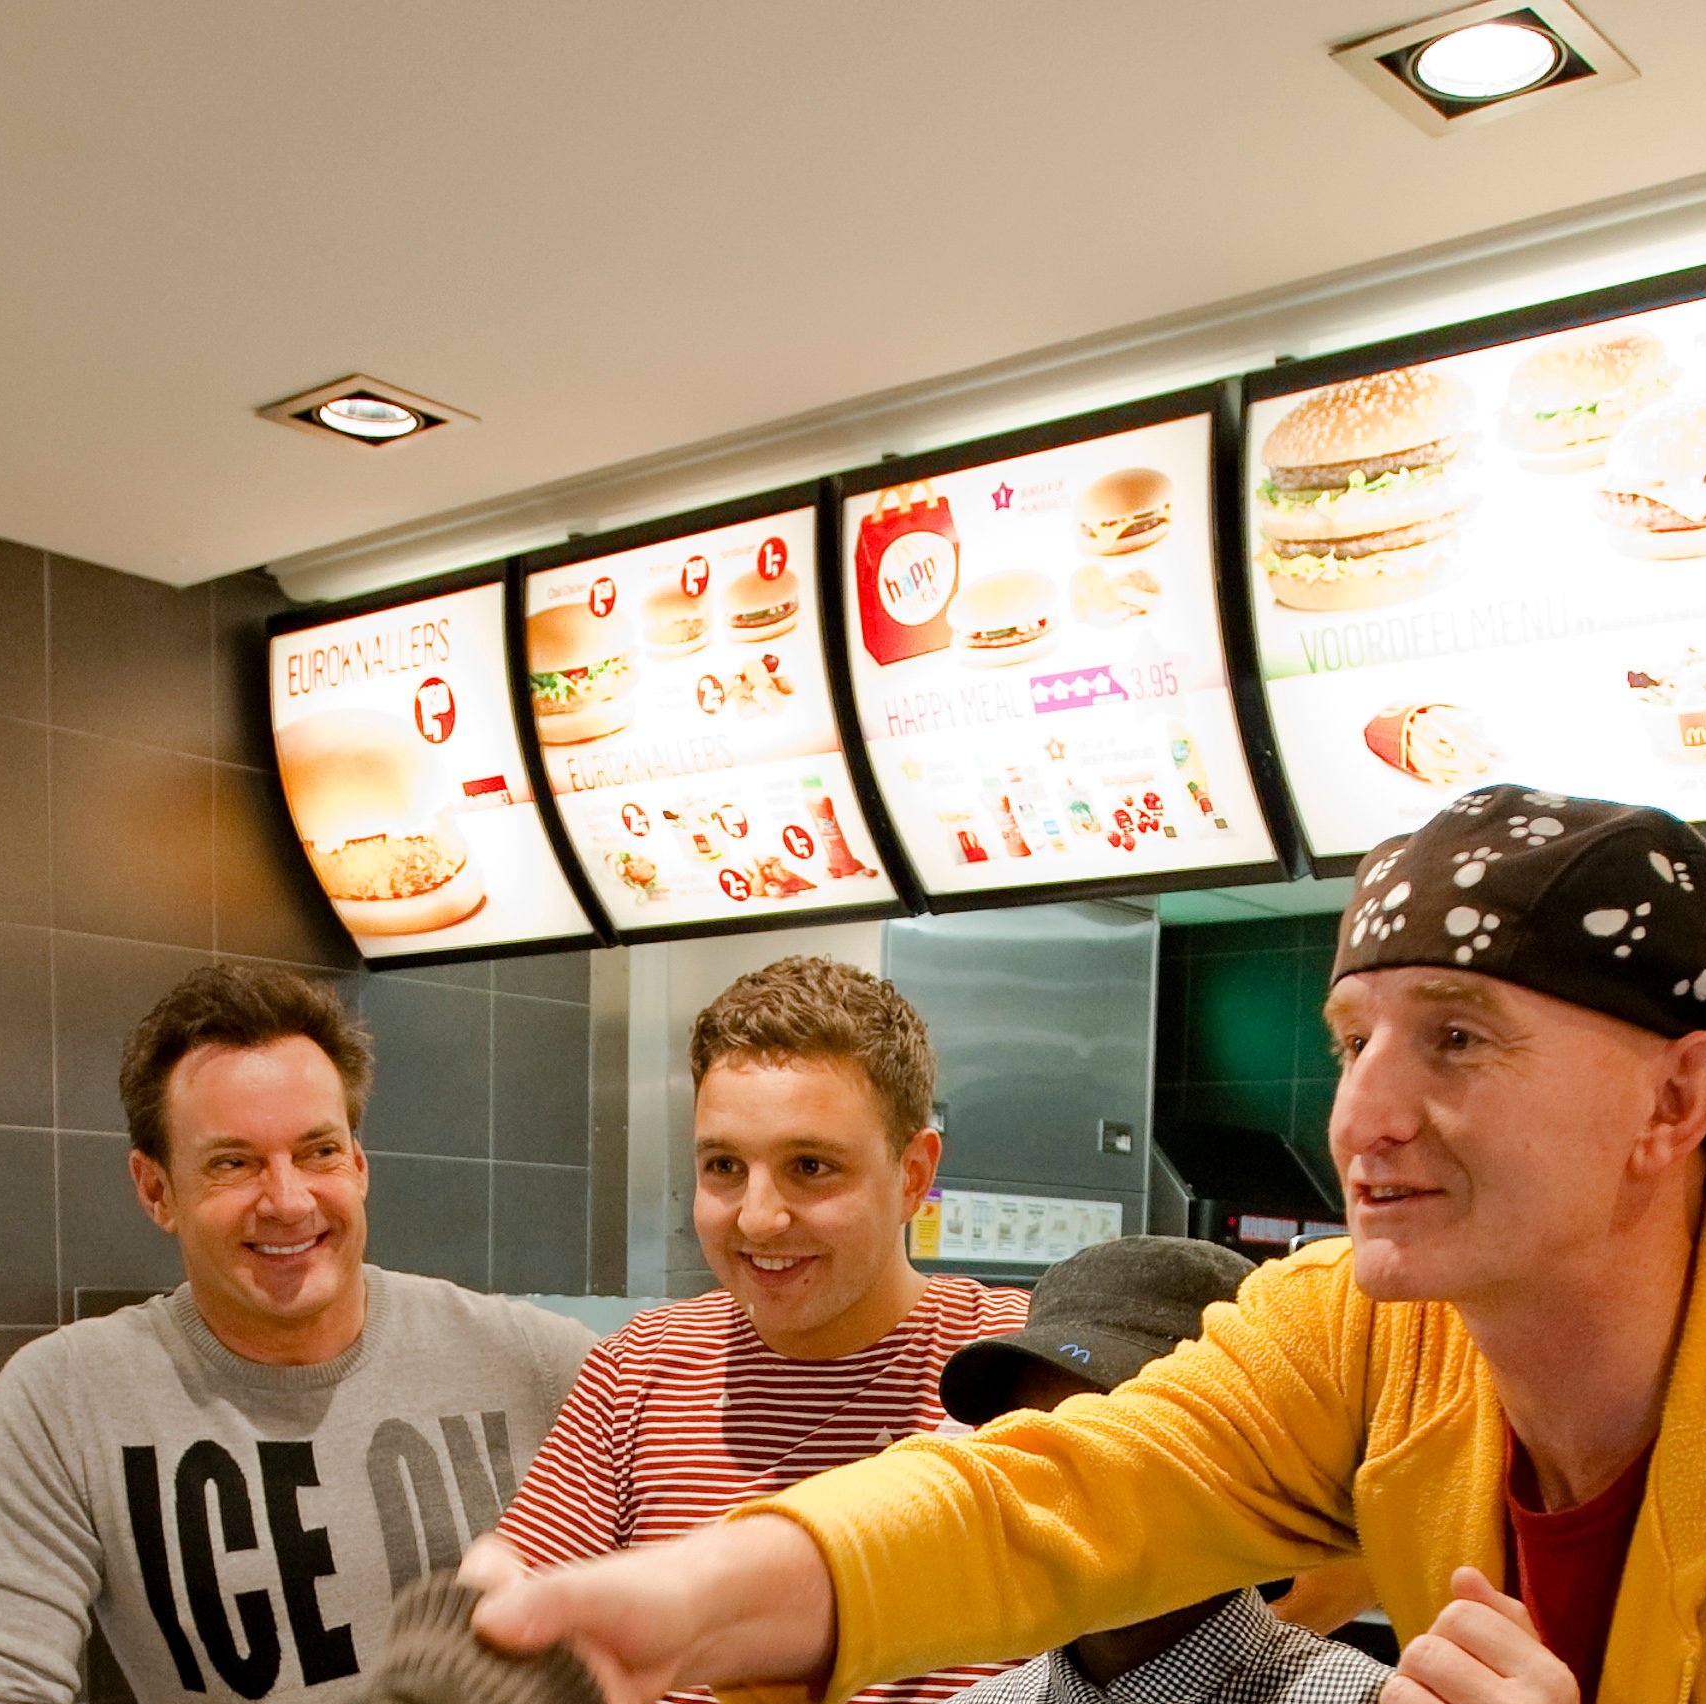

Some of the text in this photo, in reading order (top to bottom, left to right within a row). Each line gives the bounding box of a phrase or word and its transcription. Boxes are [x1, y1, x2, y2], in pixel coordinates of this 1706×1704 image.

[884, 556, 936, 603] happ
[287, 617, 451, 697] EUROKNALLERS
[1299, 591, 1569, 674] VOORDEELMENU
[883, 680, 1026, 737] HAPPY MEAL
[1130, 661, 1179, 701] 3.95
[567, 734, 734, 791] EUROKNALLERS
[121, 1439, 359, 1701] ICE
